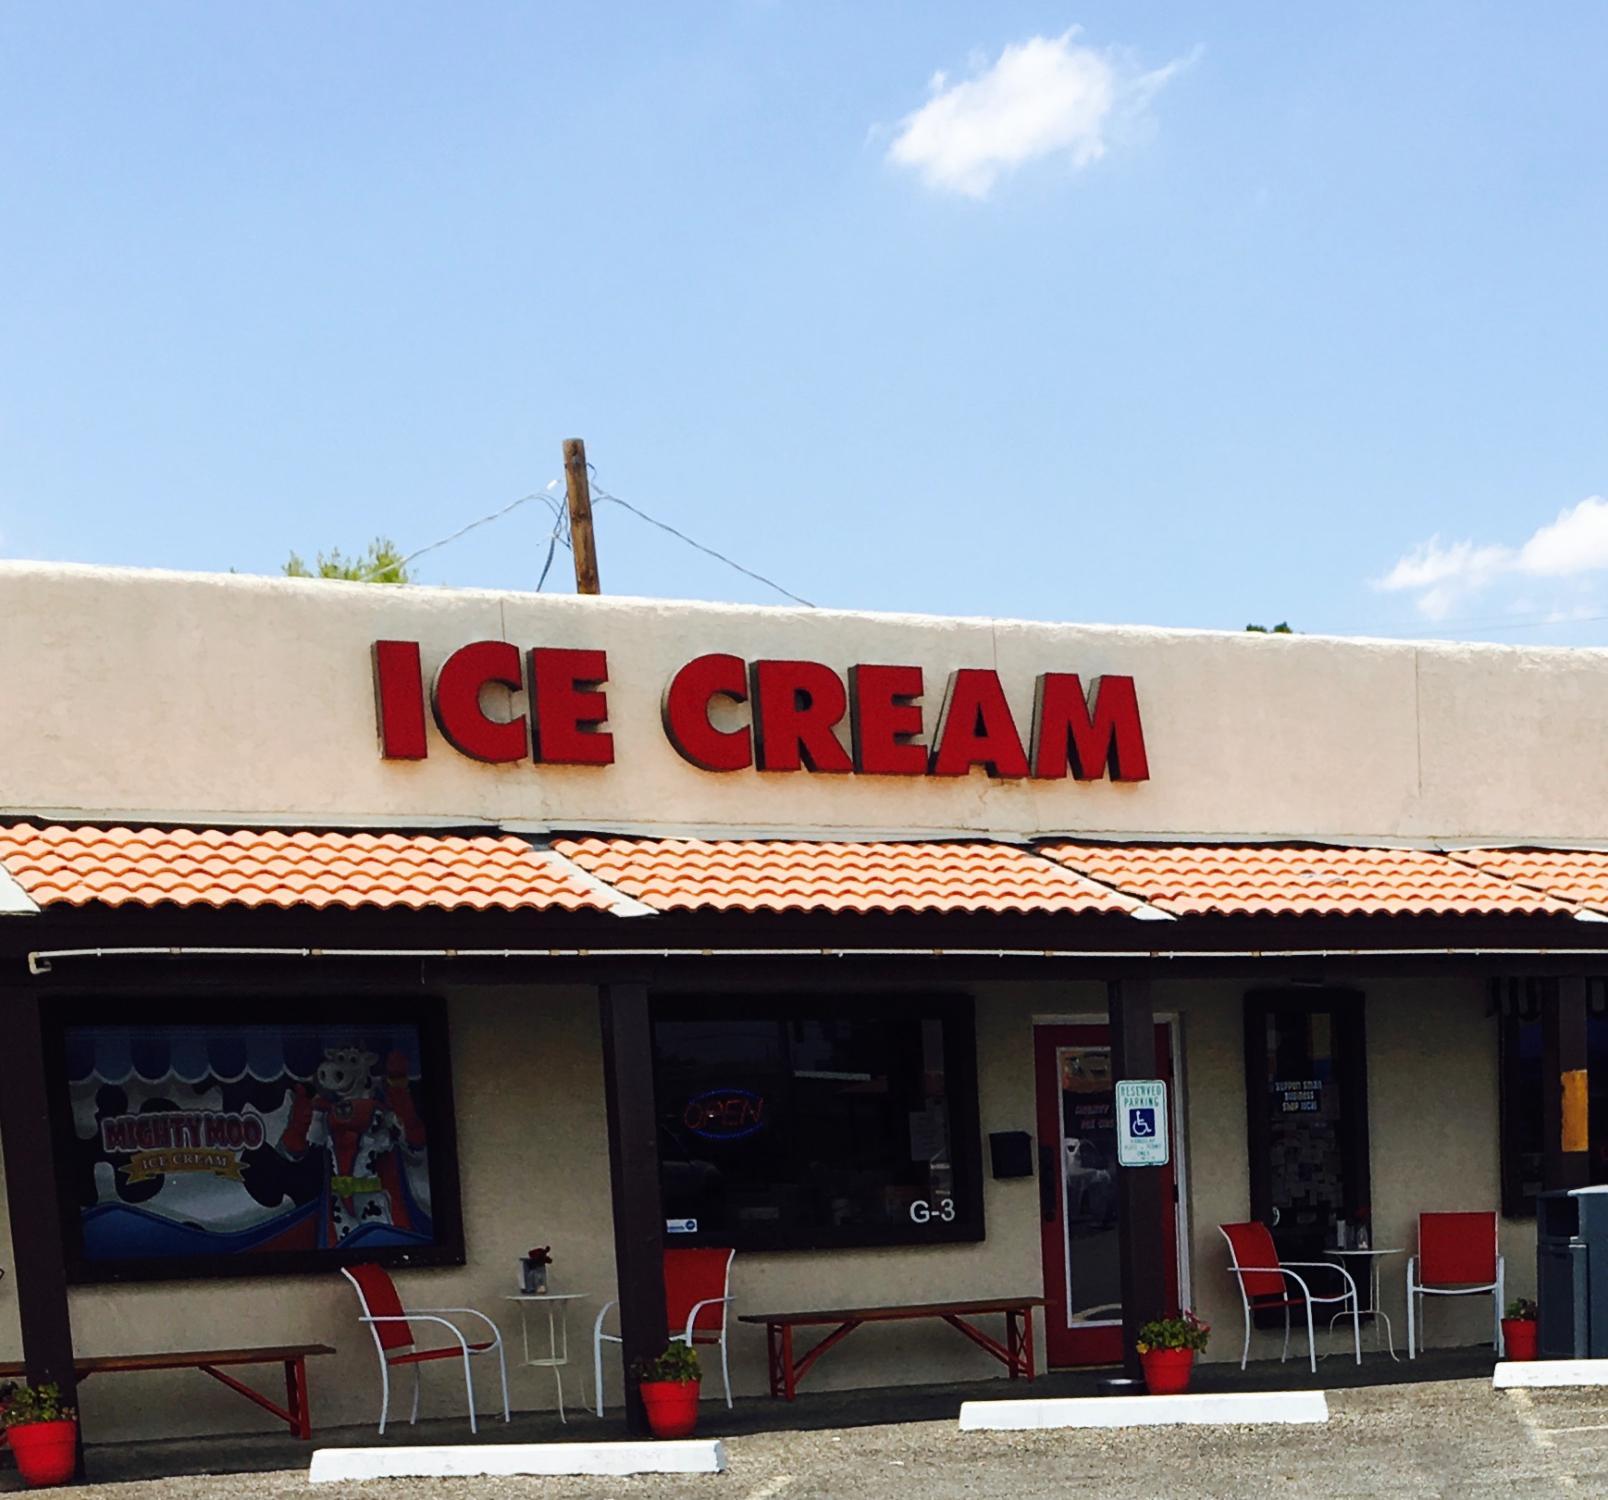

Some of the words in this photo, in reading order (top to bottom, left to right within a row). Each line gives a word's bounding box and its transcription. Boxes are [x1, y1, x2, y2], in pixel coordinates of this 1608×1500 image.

[370, 640, 615, 764] ICE
[661, 653, 1150, 781] CREAM
[1120, 1085, 1162, 1096] RESERVED
[1124, 1097, 1159, 1107] PARKING
[684, 1096, 765, 1128] OPEN
[103, 1114, 202, 1152] MIGHTY
[204, 1112, 263, 1150] MOO
[142, 1153, 168, 1169] ICE
[172, 1153, 228, 1167] CREAM
[910, 1198, 955, 1223] G-3
